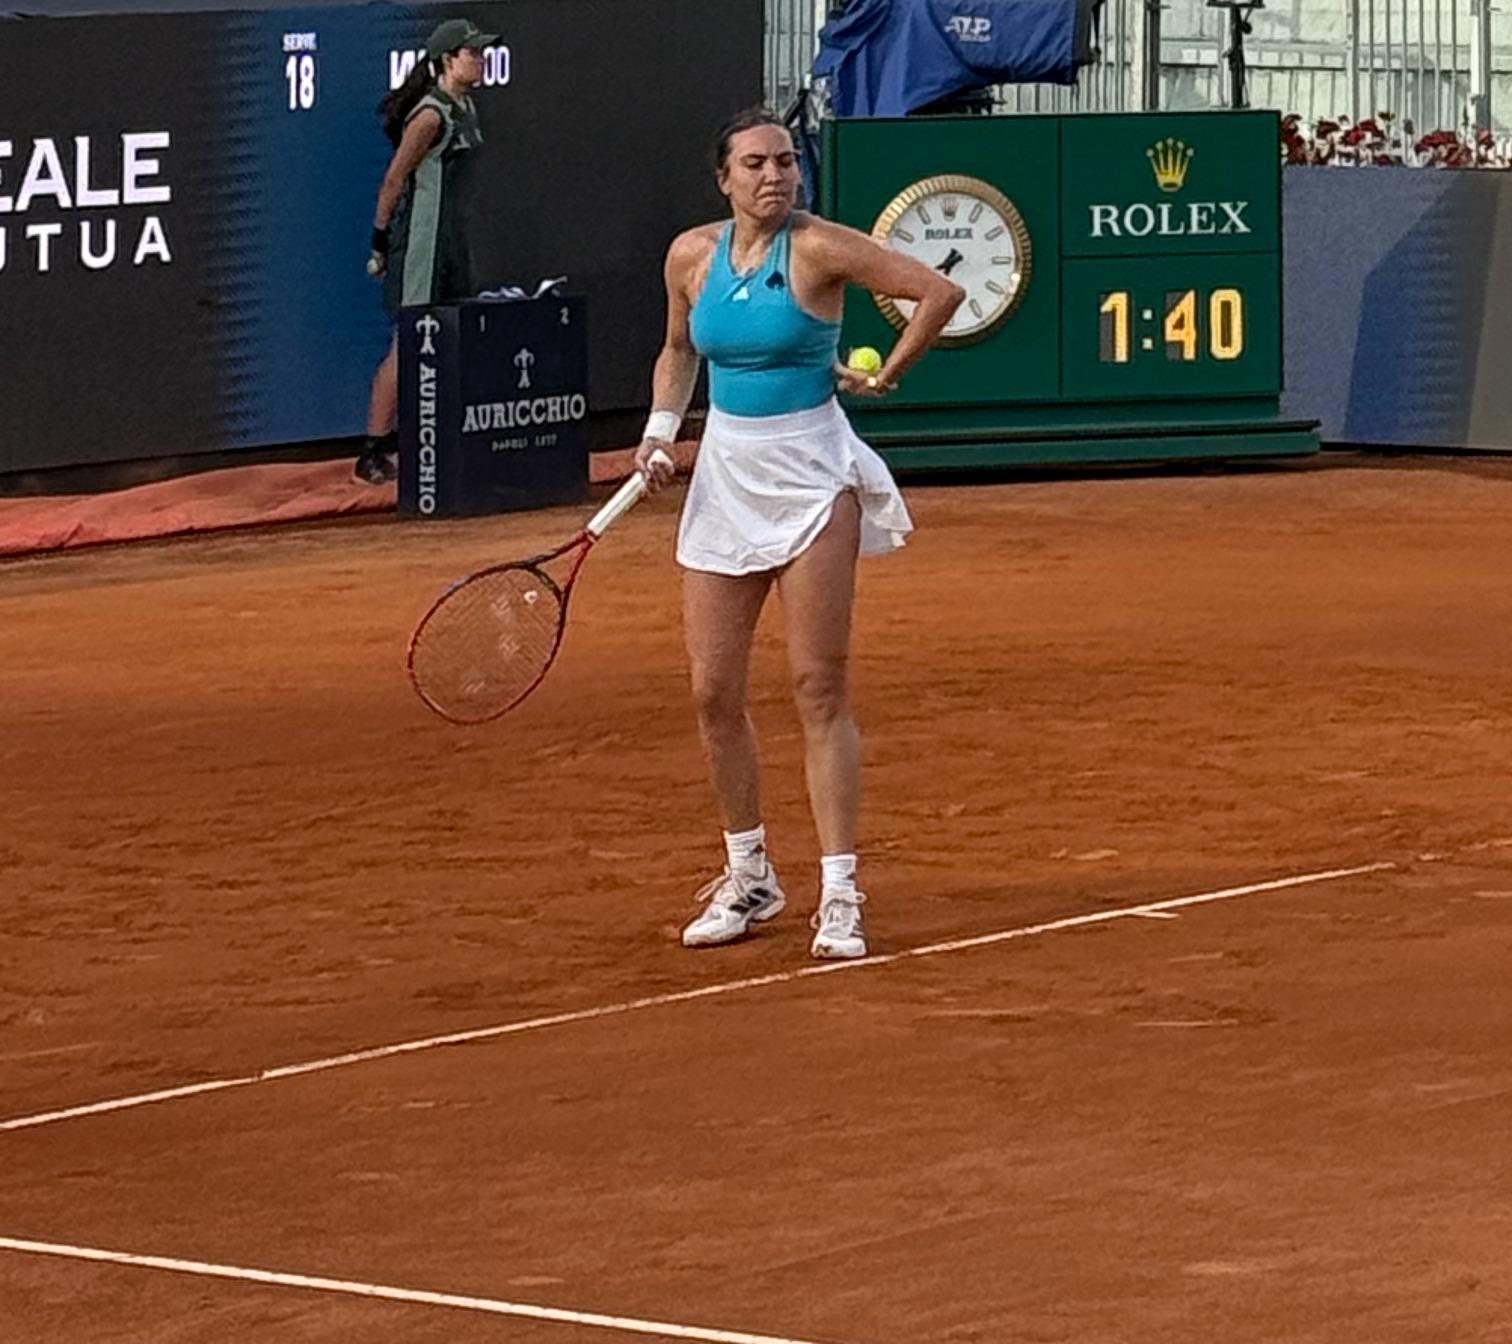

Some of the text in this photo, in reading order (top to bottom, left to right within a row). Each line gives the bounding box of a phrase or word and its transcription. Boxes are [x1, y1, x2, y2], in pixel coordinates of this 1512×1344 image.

[286, 55, 314, 110] 18
[0, 132, 171, 212] ALE
[0, 216, 172, 271] TUA
[924, 228, 974, 241] ROLEX
[1089, 201, 1251, 237] ROLEX
[1100, 289, 1243, 362] 1:40
[419, 363, 437, 514] AURICCHIO
[462, 393, 586, 432] AURICCHIO
